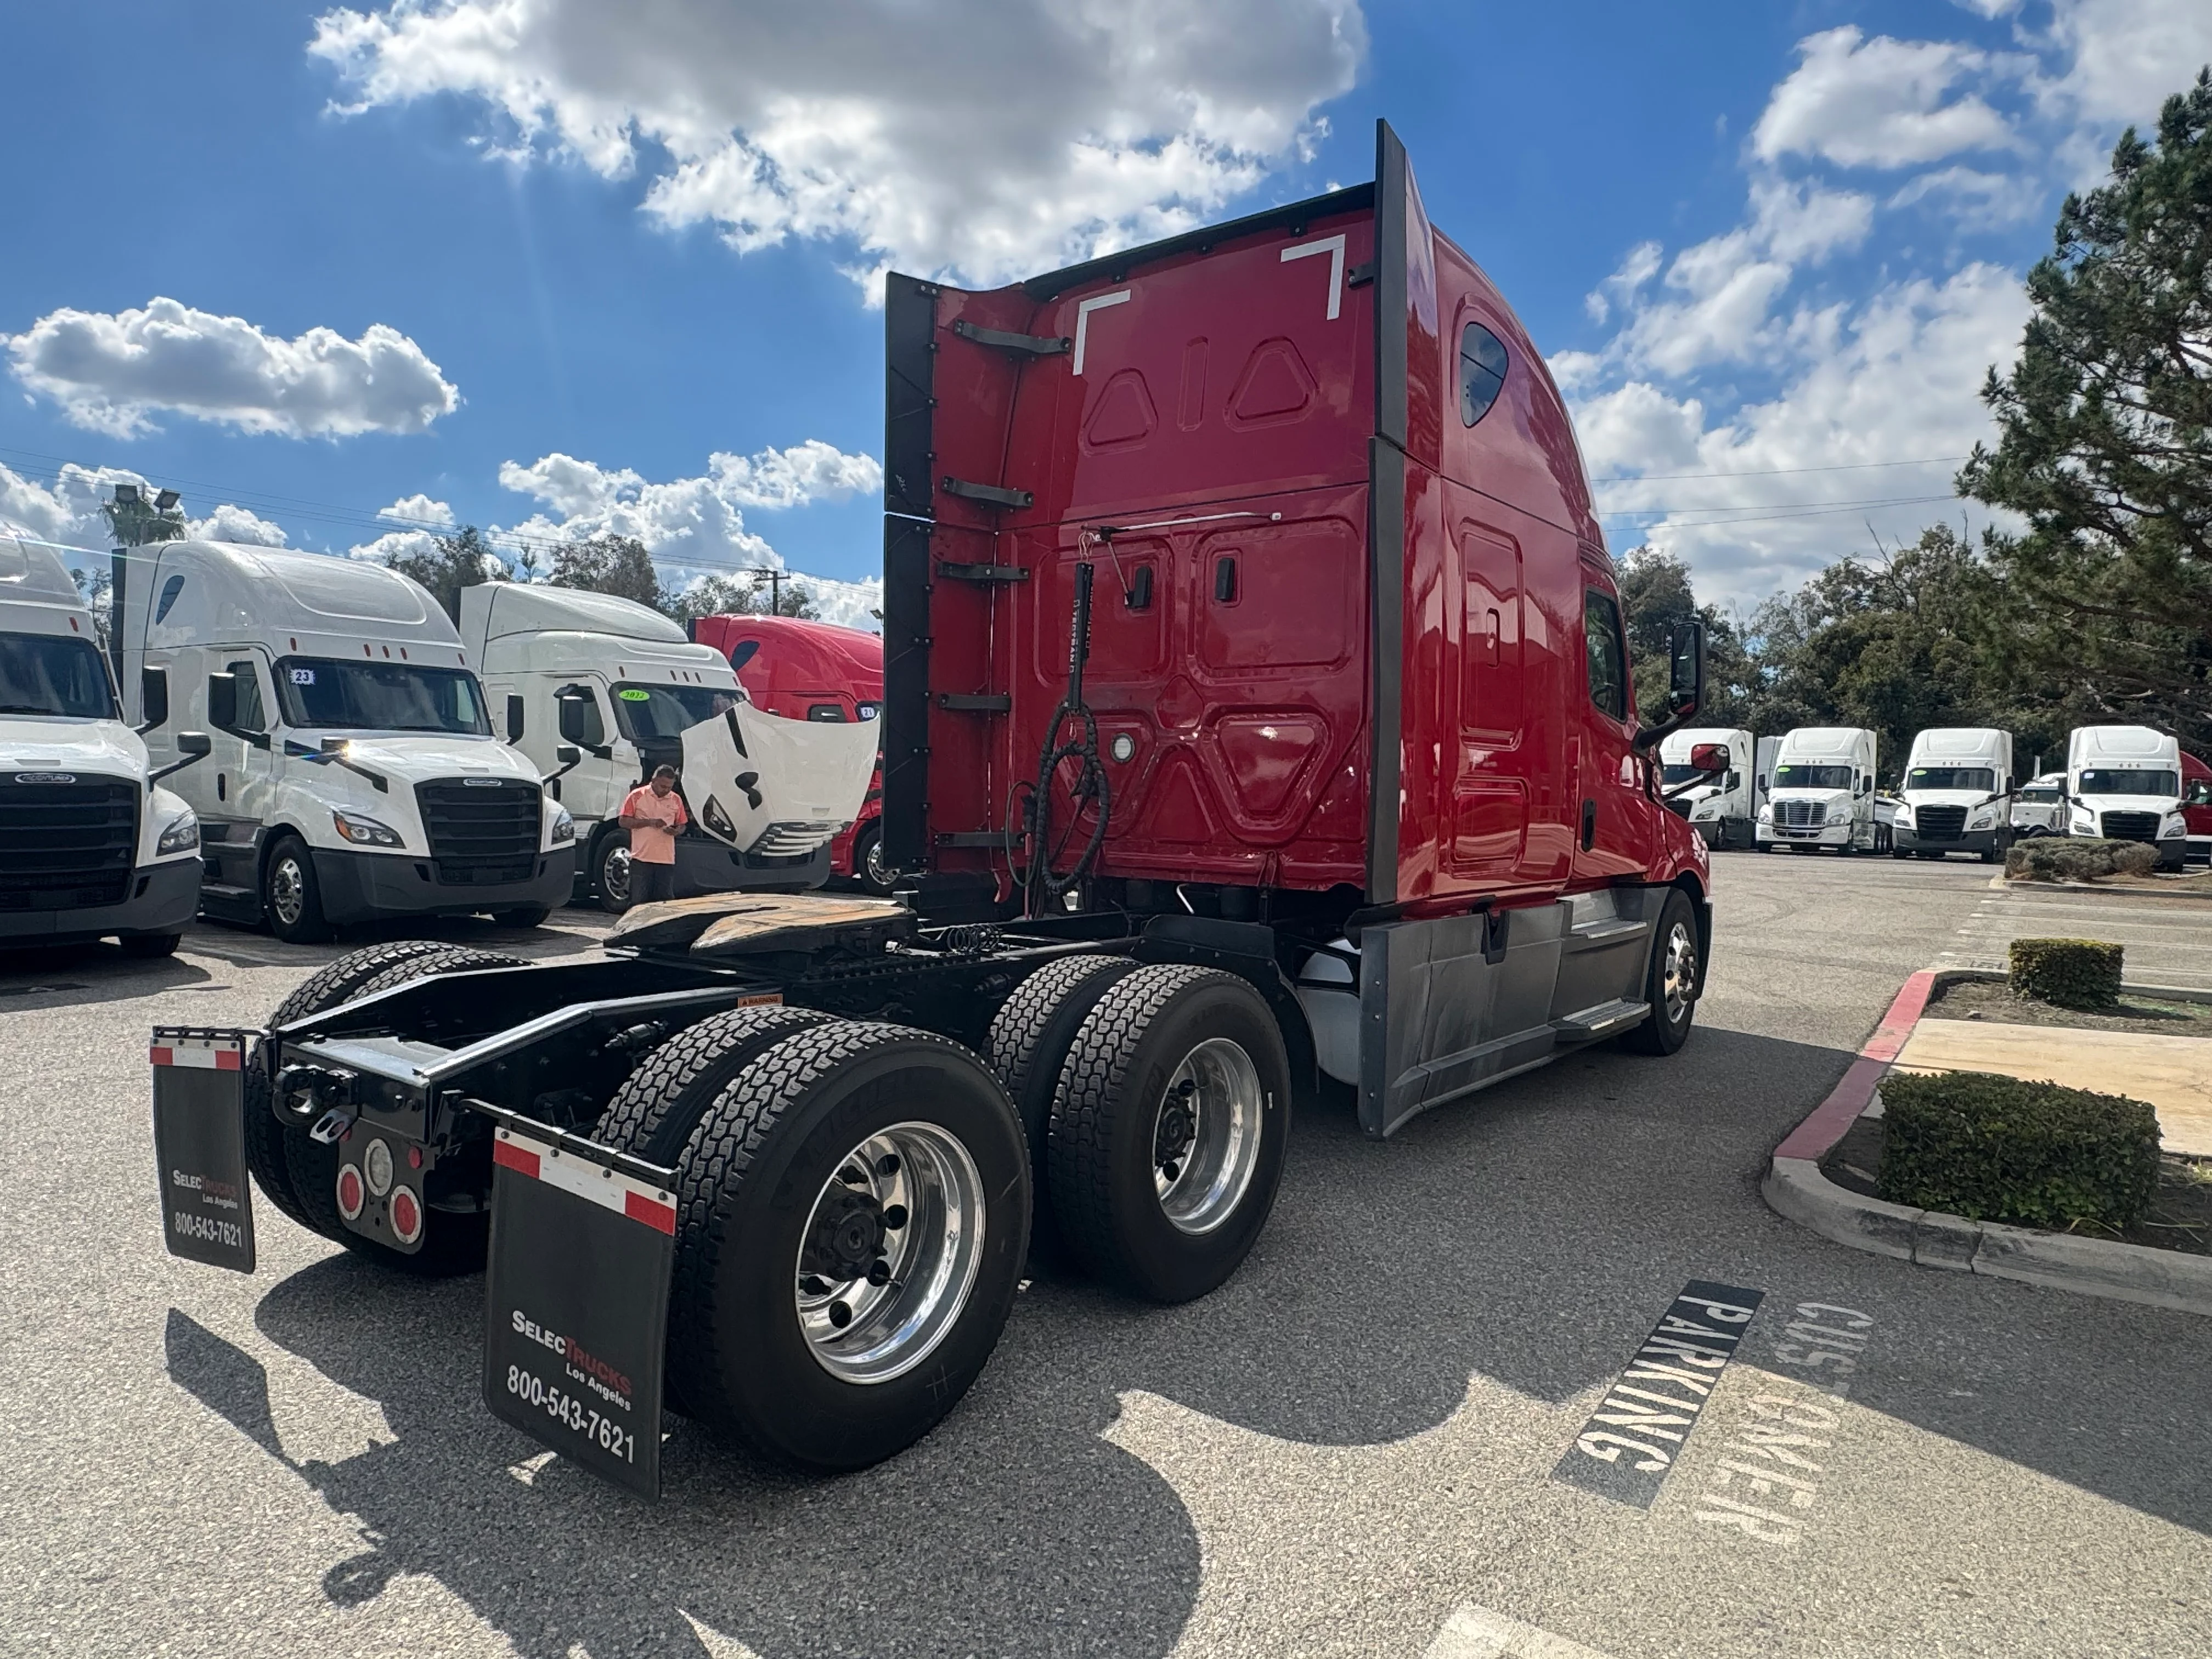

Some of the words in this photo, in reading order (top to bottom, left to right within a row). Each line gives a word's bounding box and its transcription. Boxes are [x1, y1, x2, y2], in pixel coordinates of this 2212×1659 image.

[295, 672, 309, 681] 23
[202, 1193, 214, 1204] Los
[215, 1196, 238, 1209] Angeles
[175, 1211, 242, 1248] 800-543-7621
[566, 1362, 585, 1383] Los
[588, 1376, 631, 1412] Angeles
[1577, 1295, 1754, 1471] PARKING
[507, 1364, 634, 1464] 800-543-7621
